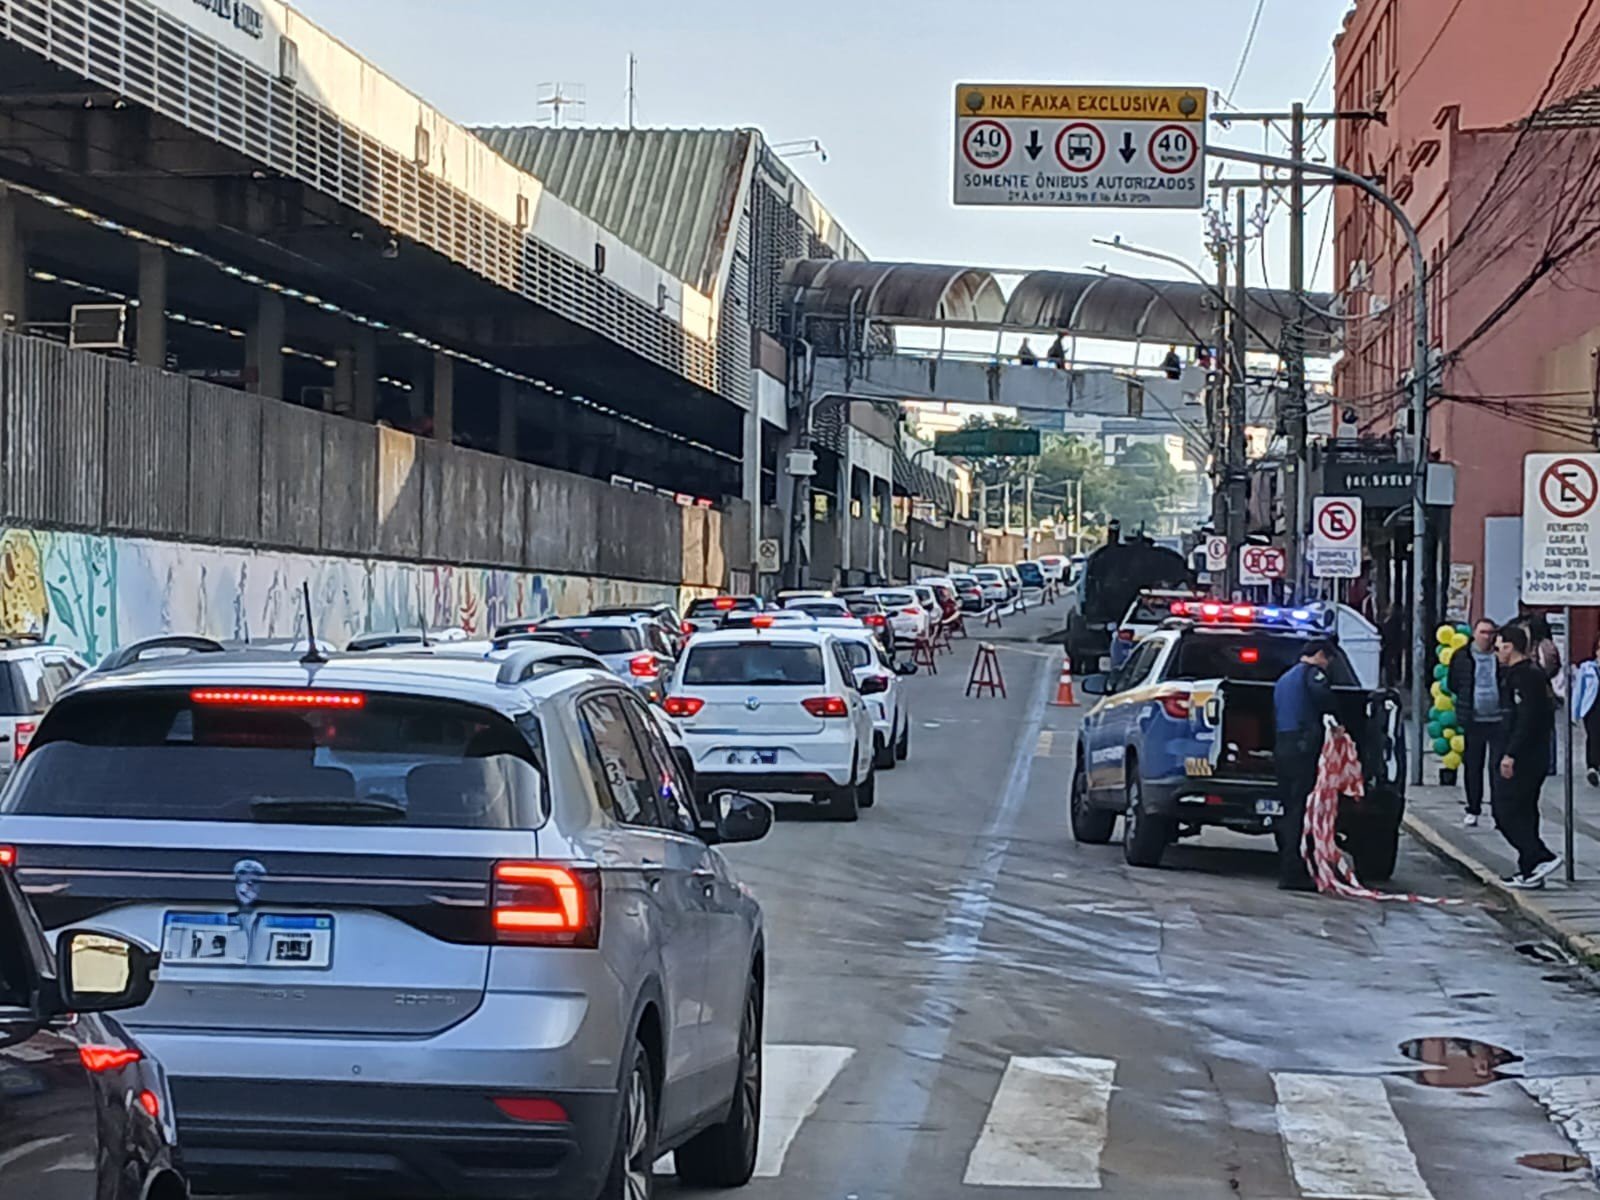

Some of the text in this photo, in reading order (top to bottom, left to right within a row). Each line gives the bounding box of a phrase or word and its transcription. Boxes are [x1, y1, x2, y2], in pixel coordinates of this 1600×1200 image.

[991, 95, 1170, 112] NA FAIXA EXCLUSIVA
[972, 129, 1001, 147] 40
[1158, 134, 1187, 152] 40
[963, 172, 1195, 191] SOMENTE ÔNIBUS AUTORIZADOS
